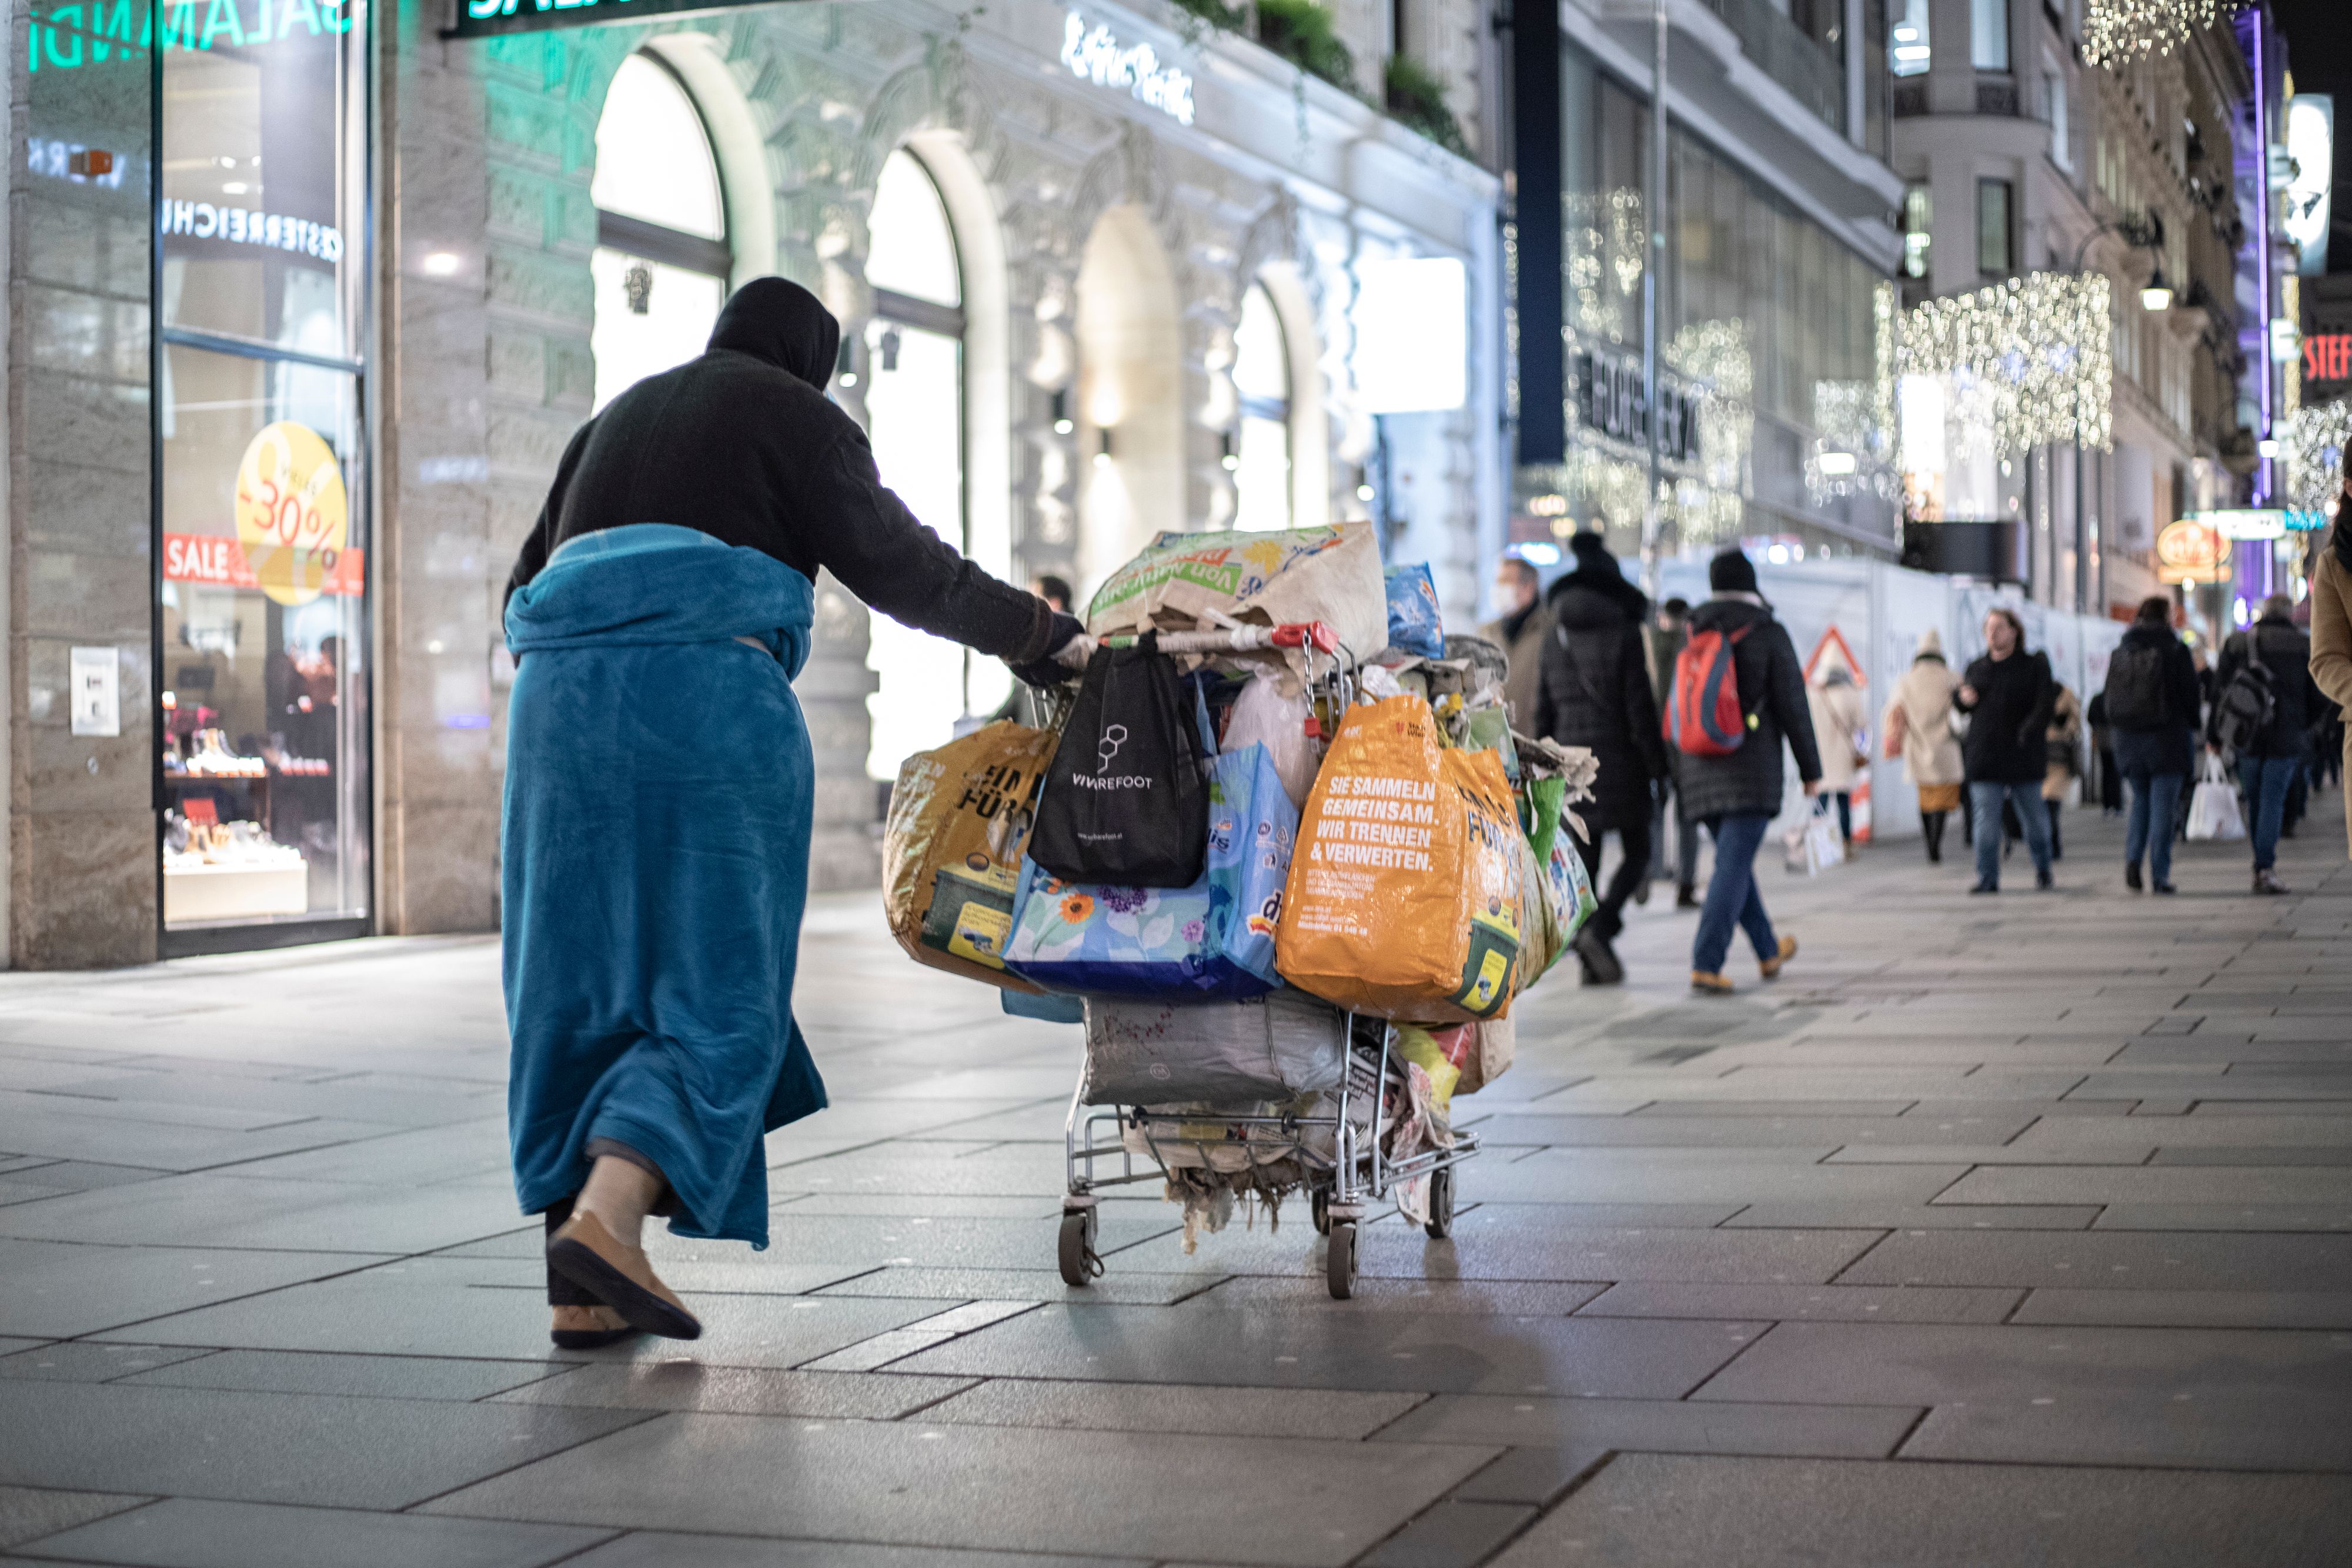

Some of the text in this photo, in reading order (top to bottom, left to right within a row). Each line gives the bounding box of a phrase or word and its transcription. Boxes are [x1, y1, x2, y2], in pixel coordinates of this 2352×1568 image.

[239, 480, 336, 570] -30%
[168, 540, 228, 579] SALE
[1191, 563, 1231, 590] Von
[1329, 775, 1435, 801] SIE SAMMELN
[1322, 798, 1439, 825] GEMEINSAM.
[1317, 819, 1431, 848] WIR TRENNEN
[1311, 841, 1322, 861] &
[1325, 842, 1434, 872] VERWERTEN.
[1263, 891, 1282, 924] d
